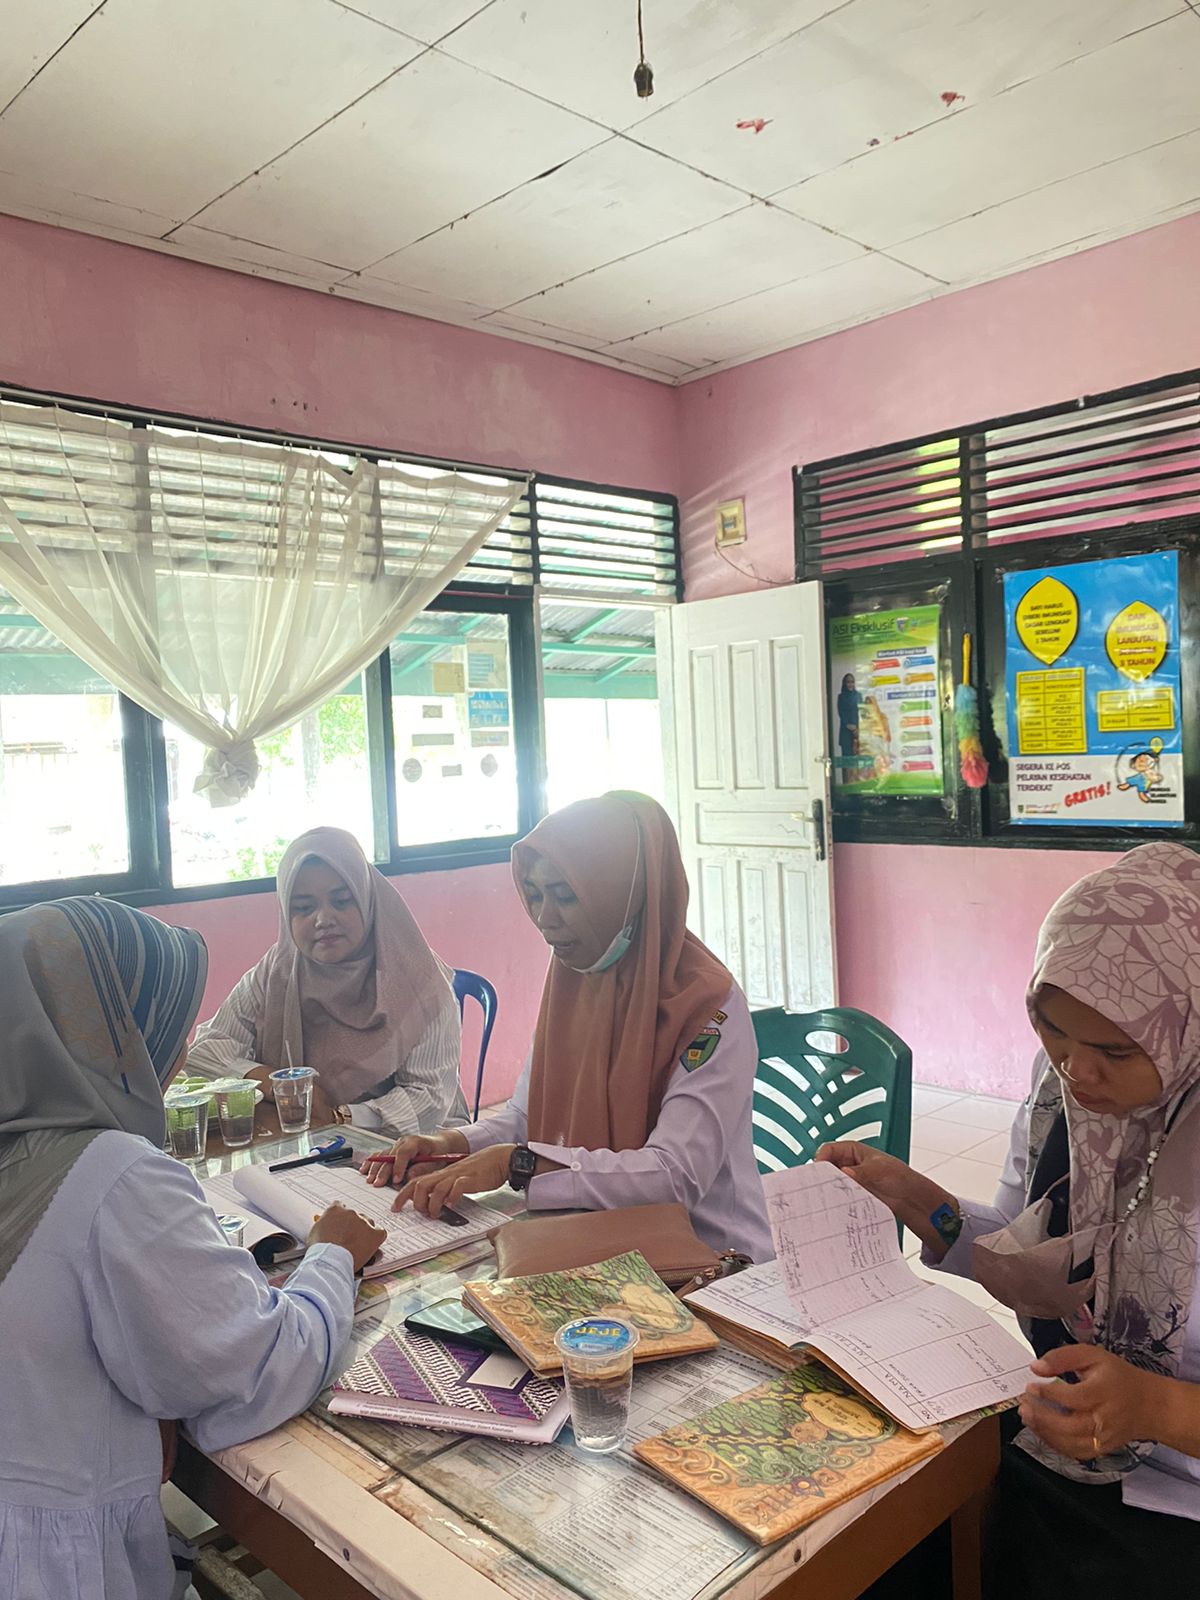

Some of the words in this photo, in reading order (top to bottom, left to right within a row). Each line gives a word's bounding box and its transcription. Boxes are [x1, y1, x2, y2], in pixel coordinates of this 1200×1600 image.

[832, 624, 848, 635] ASI
[850, 618, 895, 633] Eksklusif
[1016, 763, 1043, 771] SEGERA
[1045, 763, 1054, 771] KE
[1016, 773, 1048, 781] PELAYAN
[1049, 773, 1091, 781] KESEHATAN
[1016, 784, 1053, 792] TERDEKAT
[1064, 782, 1111, 807] GRATIS!
[575, 1327, 621, 1337] JEJE
[884, 1371, 911, 1399] NAMA
